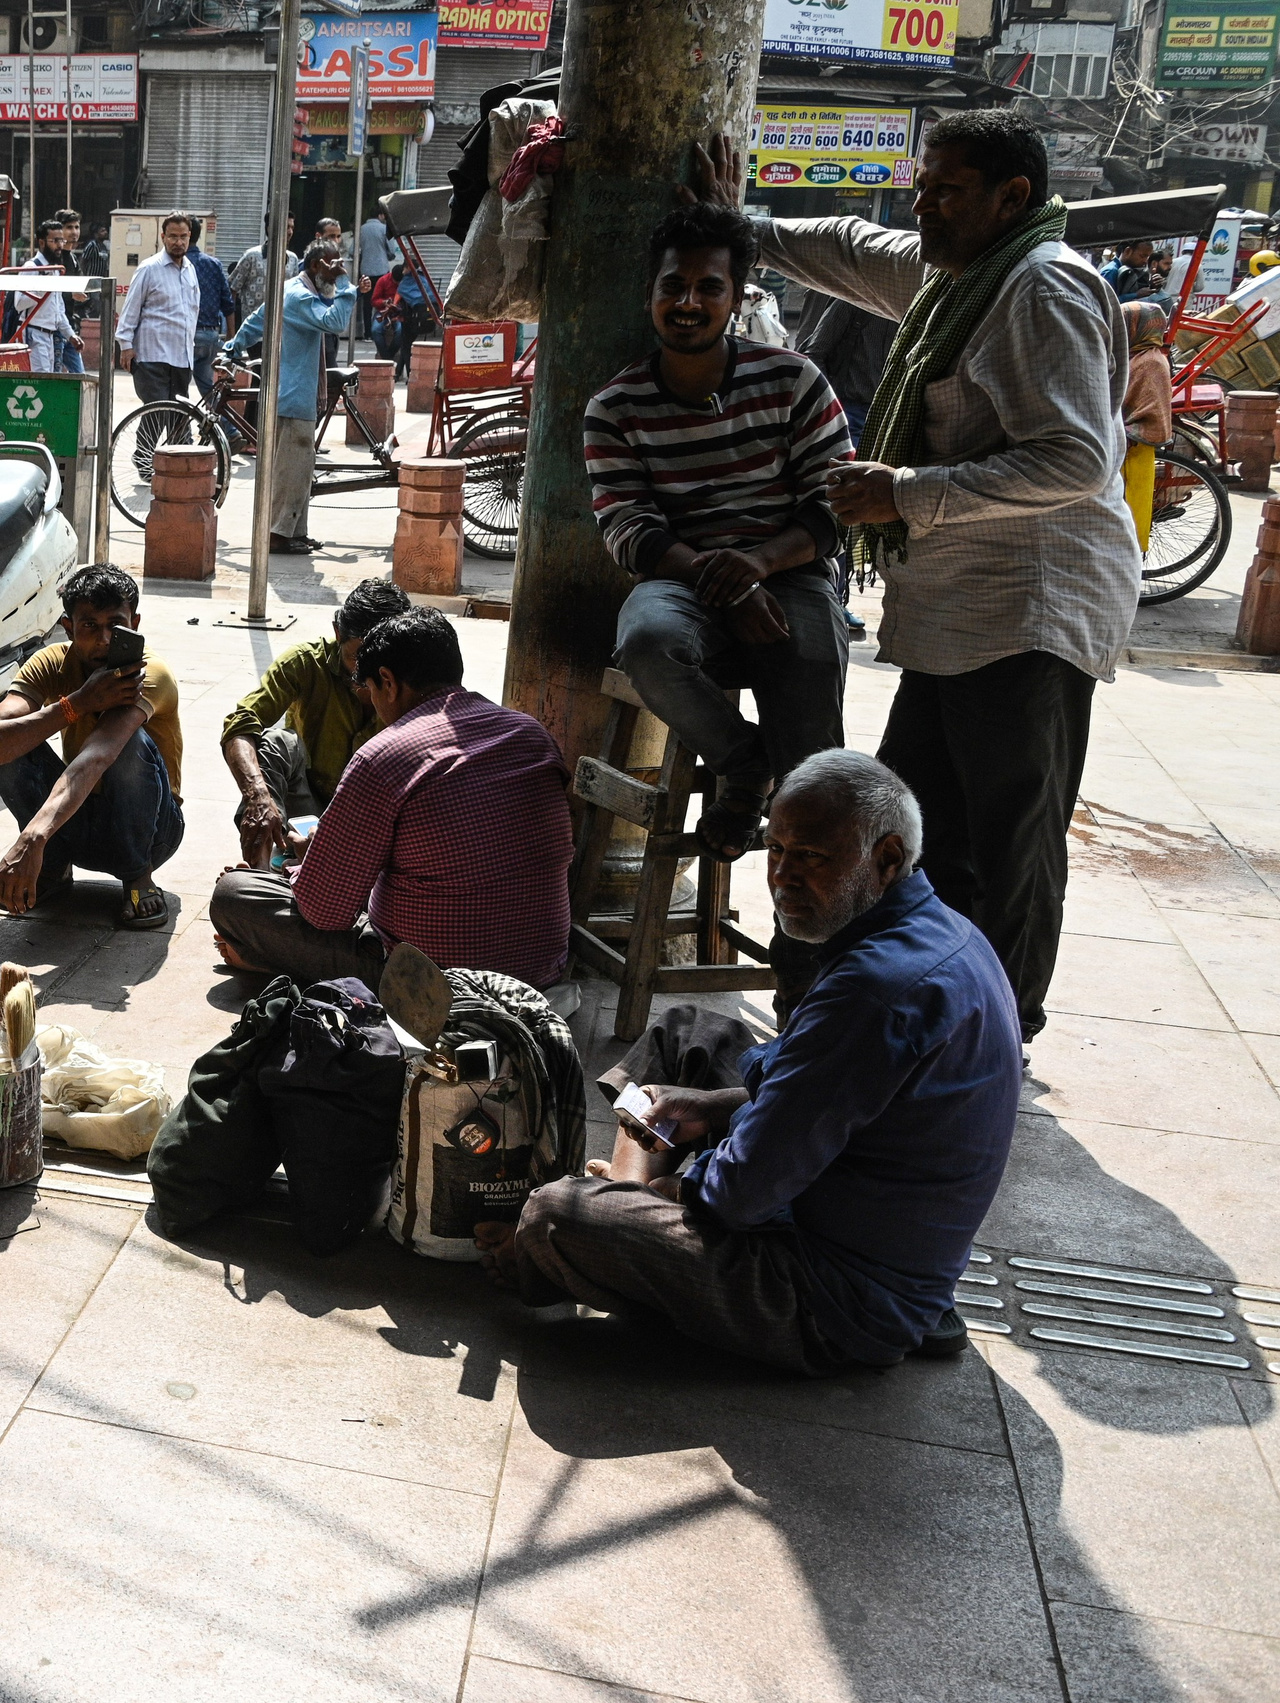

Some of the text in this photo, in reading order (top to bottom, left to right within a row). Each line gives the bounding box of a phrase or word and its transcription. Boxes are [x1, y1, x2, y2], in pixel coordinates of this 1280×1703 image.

[438, 6, 548, 32] RADHA OPTICS
[317, 21, 412, 38] AMRITSARI
[888, 7, 945, 49] 700
[761, 40, 951, 65] EHPURI, DELHI-110006 9873681625, 9811681625
[102, 64, 133, 72] CASIO
[1176, 66, 1218, 76] CROWN
[22, 88, 53, 96] TMEX
[62, 91, 93, 99] TTAN
[309, 110, 351, 129] FAMOU
[762, 133, 786, 145] 800
[789, 134, 812, 146] 270
[815, 135, 839, 147] 600
[842, 129, 874, 147] 640
[876, 131, 905, 147] 680
[894, 160, 913, 179] 680
[484, 1192, 521, 1200] GRANULES
